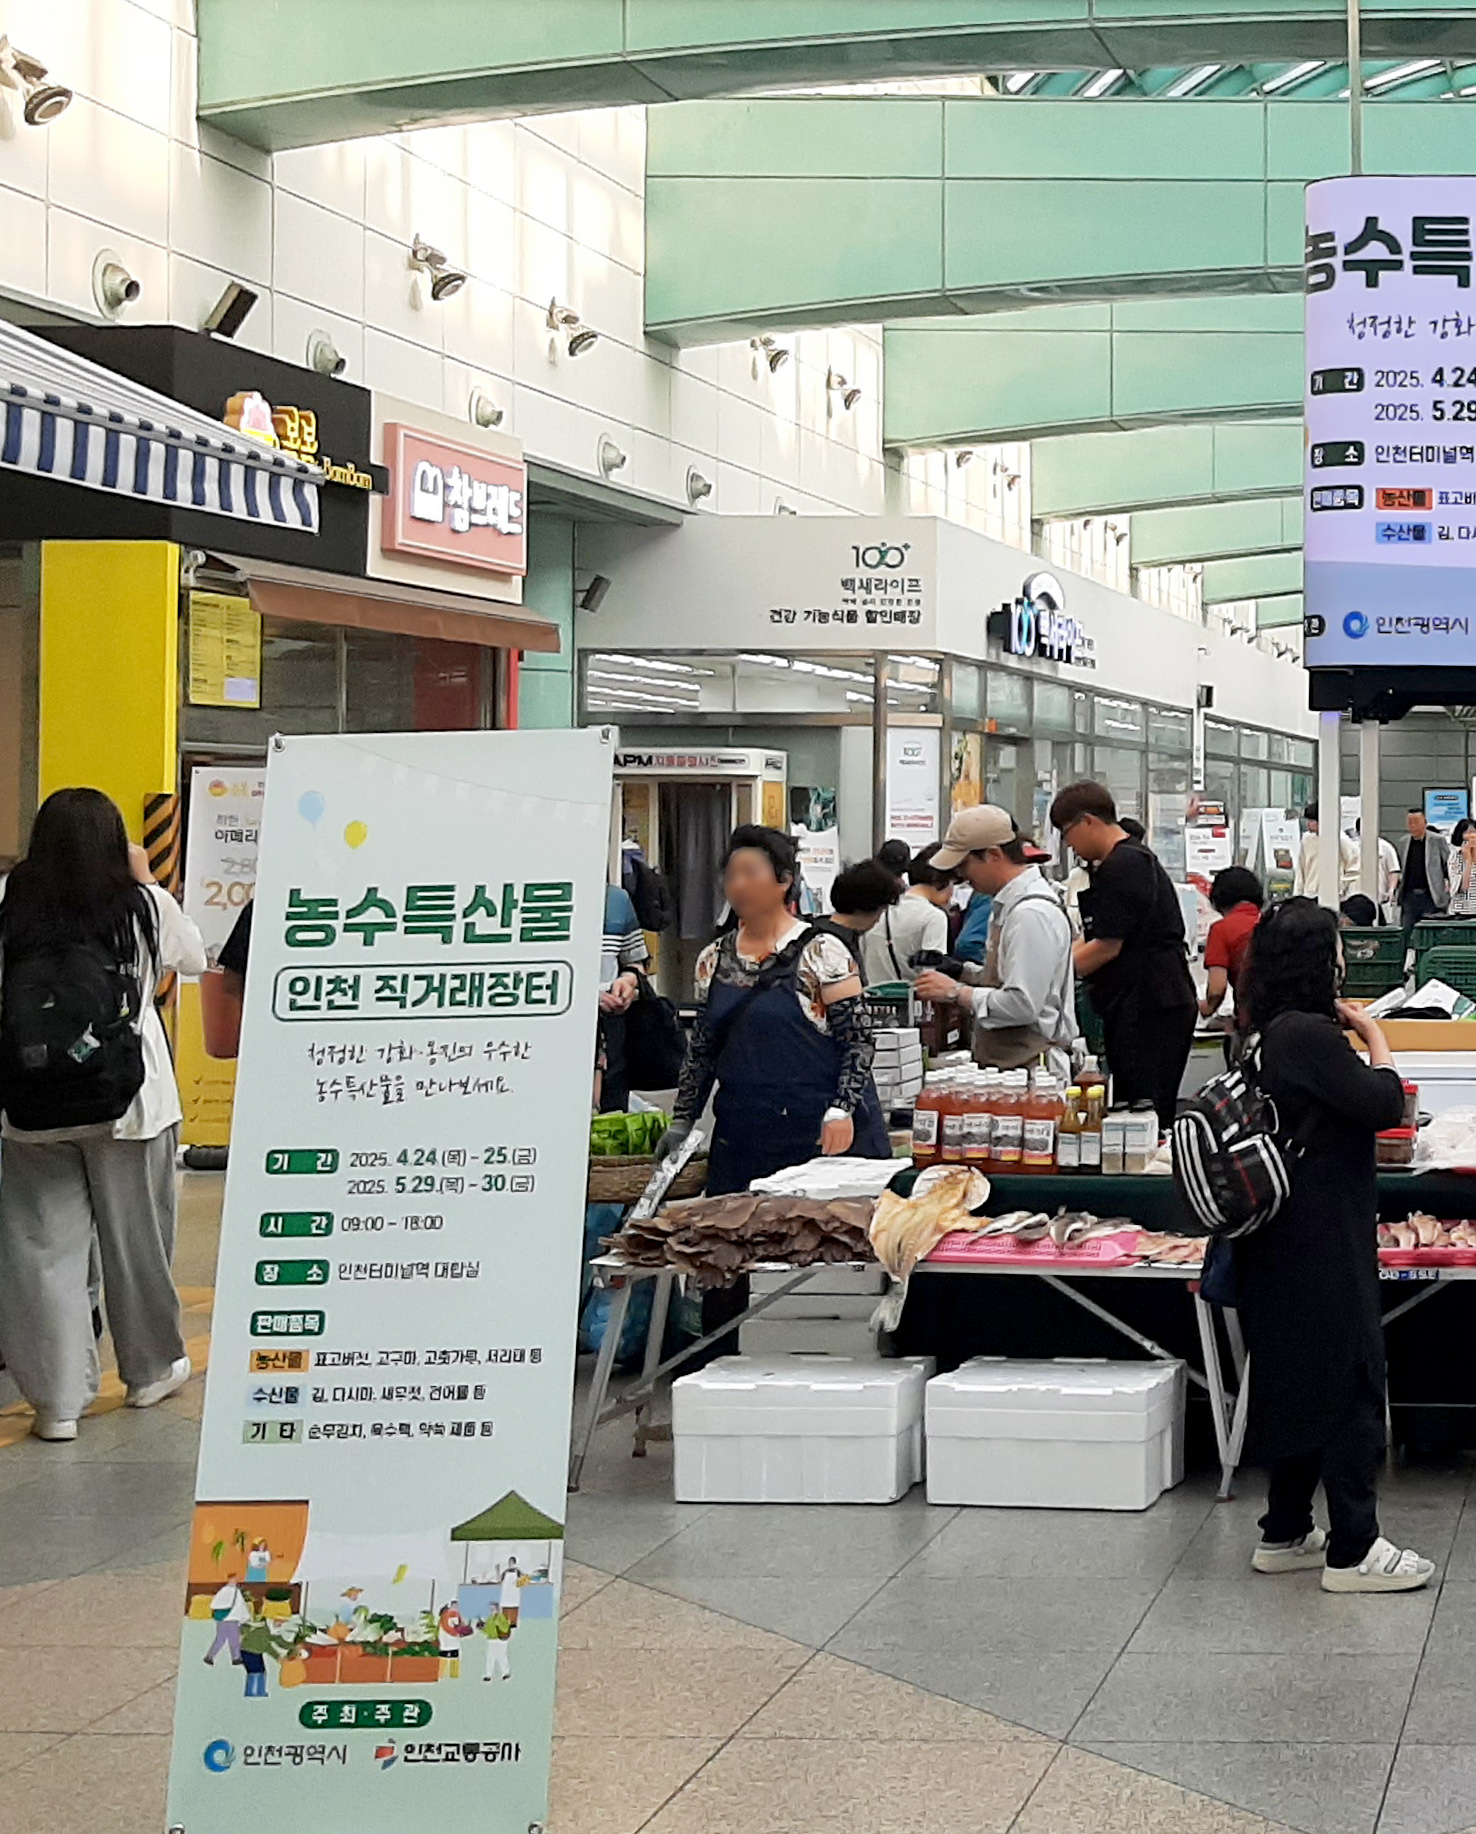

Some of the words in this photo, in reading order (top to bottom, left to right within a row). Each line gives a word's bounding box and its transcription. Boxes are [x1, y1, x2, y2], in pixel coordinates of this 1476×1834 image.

[1347, 312, 1417, 342] 청정한
[1374, 370, 1424, 388] 2025.
[1374, 403, 1424, 421] 2025.
[1375, 445, 1474, 464] 인천터미널역
[841, 577, 923, 595] 백세라이프
[1376, 616, 1469, 635] 인천광역시
[285, 882, 574, 948] 농수특산물
[289, 974, 361, 1011] 인천
[374, 970, 559, 1009] 직거래장터
[308, 1042, 365, 1066] 청정한
[483, 1041, 531, 1062] 우수한
[316, 1074, 406, 1105] 농수특산물을
[350, 1152, 392, 1168] 2025.
[347, 1179, 388, 1194] 2025.
[341, 1216, 384, 1231] 09:00
[402, 1215, 443, 1230] 18:00
[243, 1743, 348, 1766] 인천광역시
[403, 1742, 522, 1764] 인천교통공사
